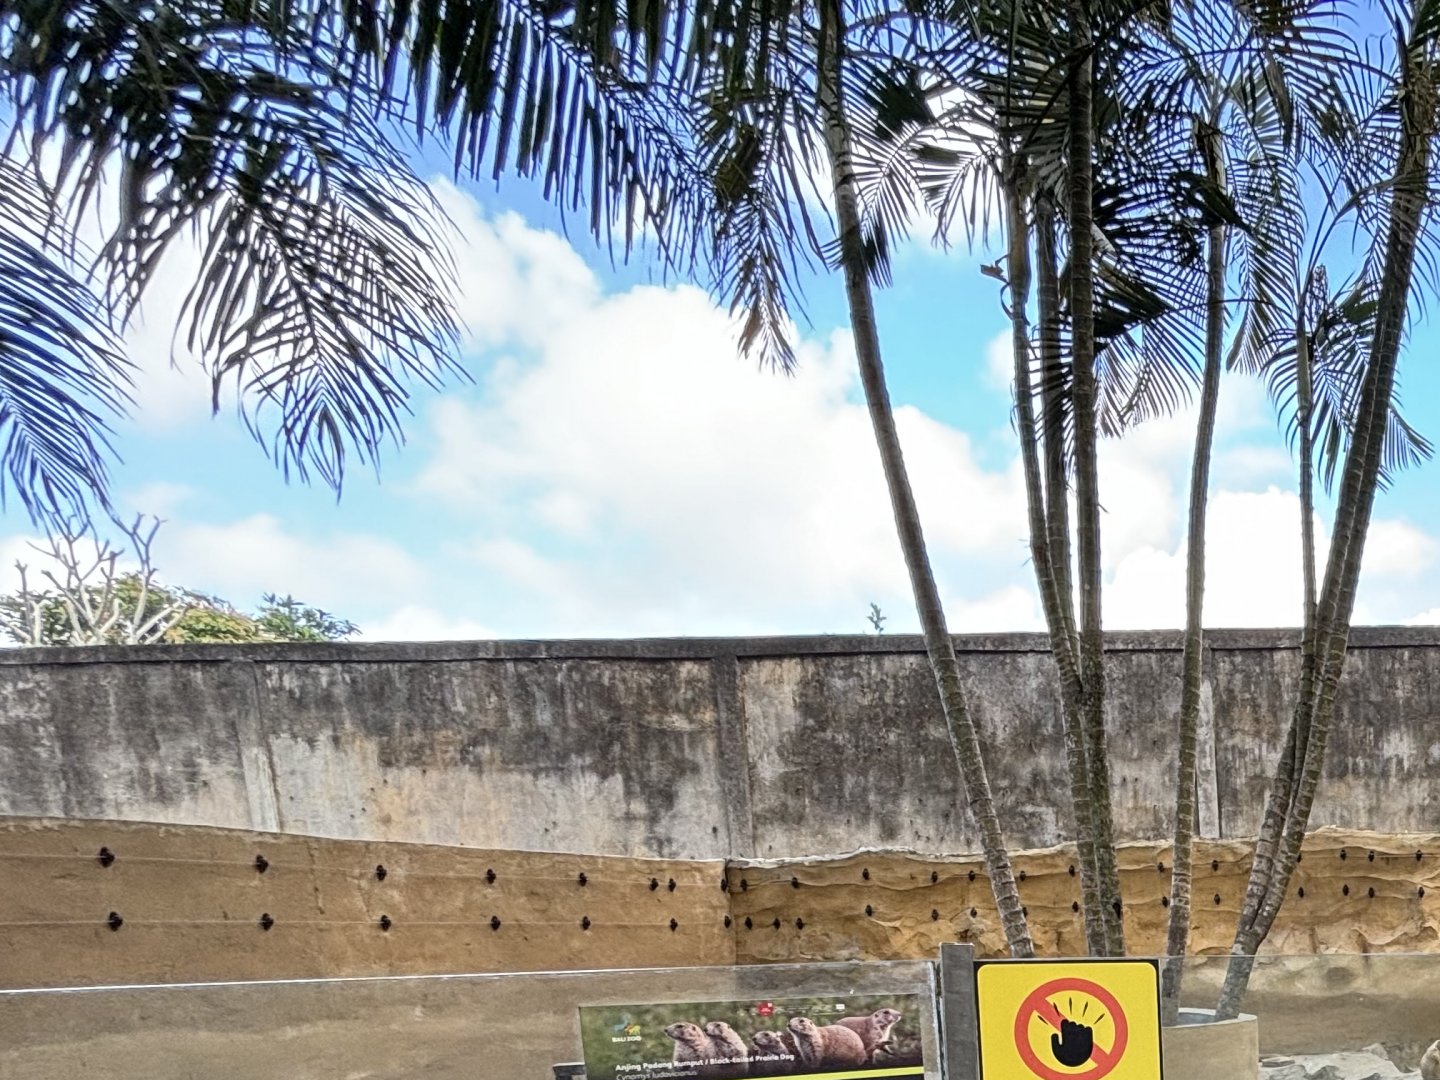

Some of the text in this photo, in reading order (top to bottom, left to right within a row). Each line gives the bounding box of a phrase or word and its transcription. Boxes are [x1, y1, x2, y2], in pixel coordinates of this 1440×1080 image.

[615, 1063, 642, 1072] Anjing
[643, 1061, 672, 1070] Padang
[673, 1059, 704, 1068] Rumput
[710, 1055, 754, 1065] Black-tailed
[755, 1054, 779, 1062] Prairie
